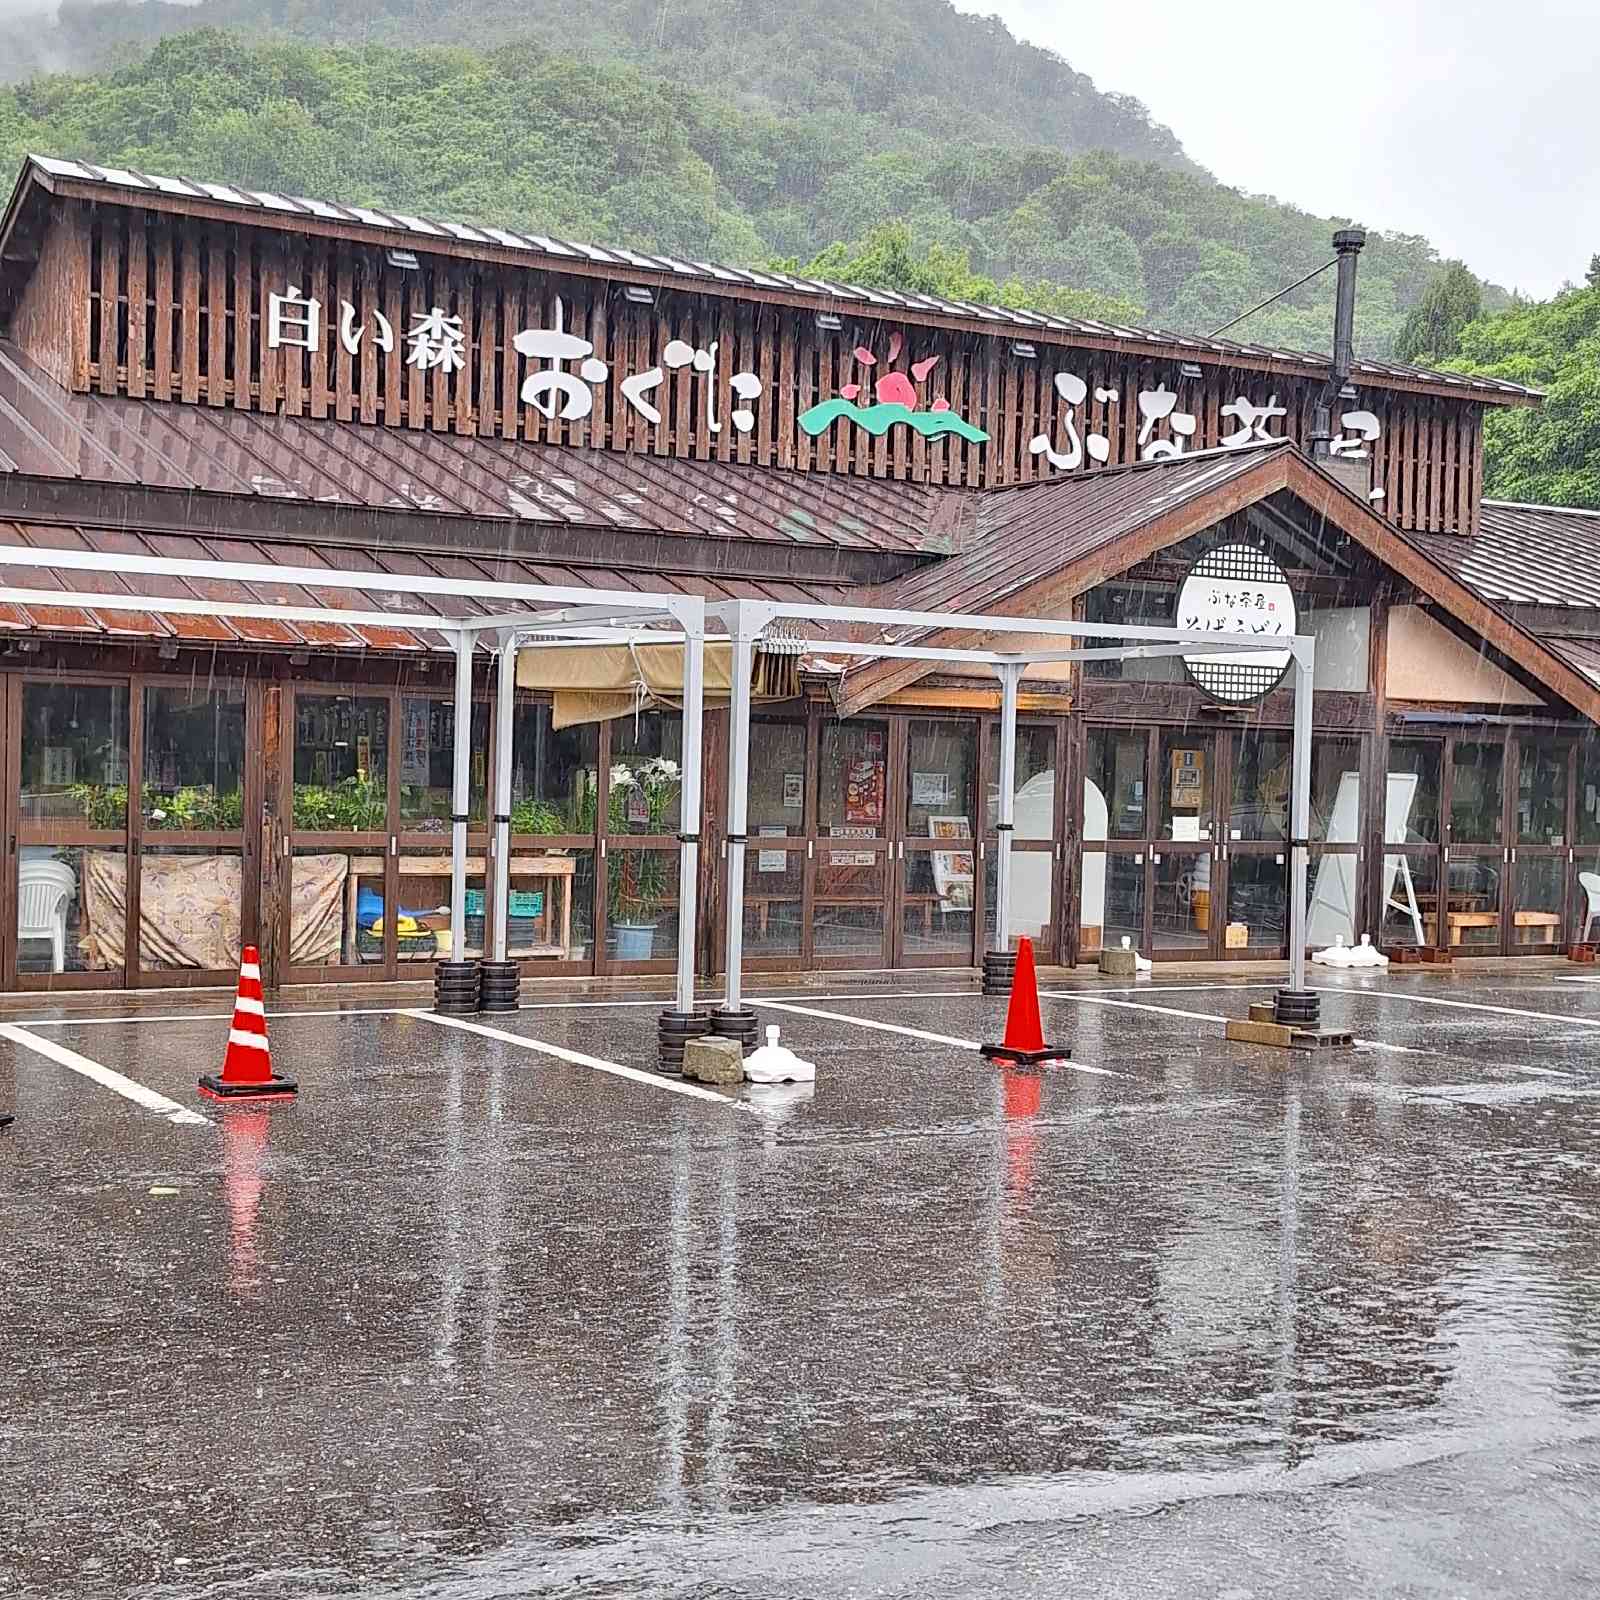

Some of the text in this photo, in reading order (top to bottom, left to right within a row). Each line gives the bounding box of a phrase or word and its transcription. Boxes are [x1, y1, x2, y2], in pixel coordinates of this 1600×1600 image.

[267, 285, 763, 433] 白い森 おぐに
